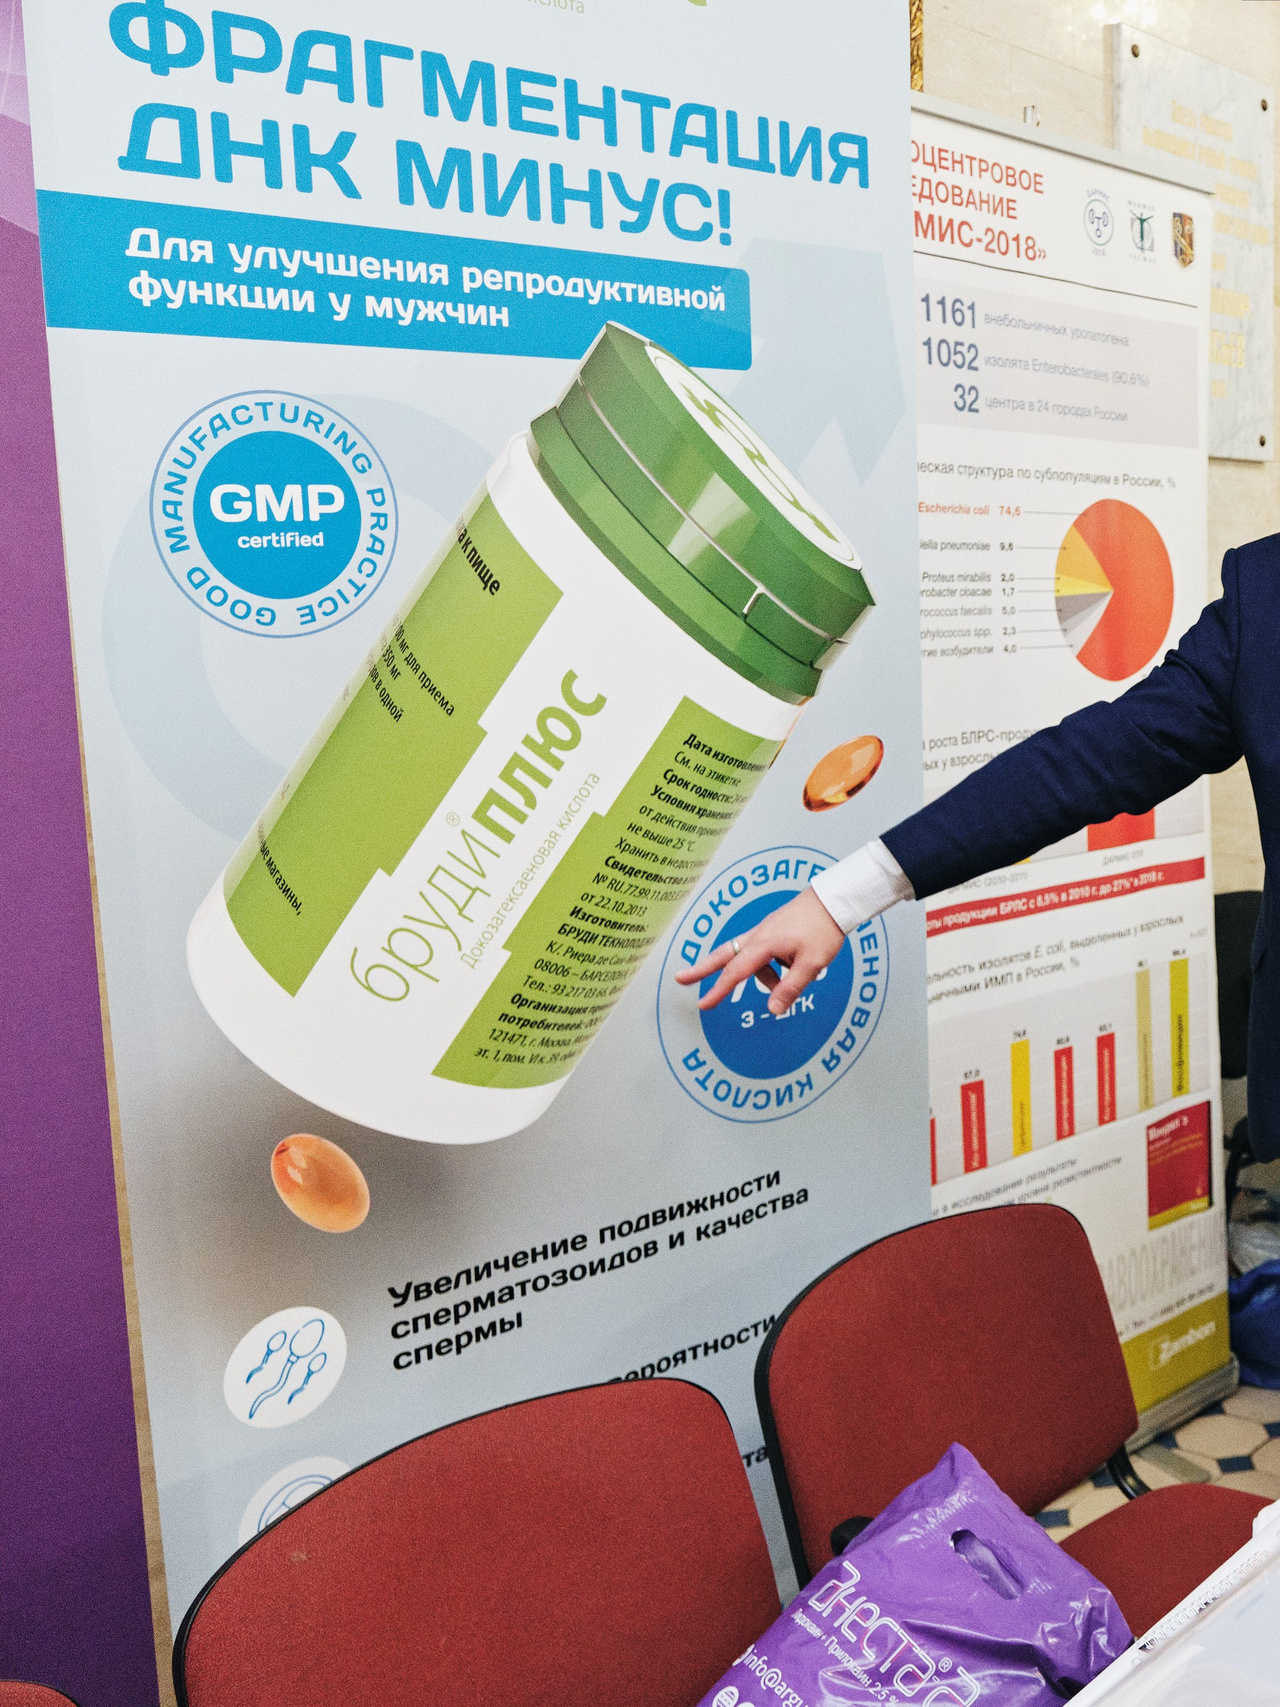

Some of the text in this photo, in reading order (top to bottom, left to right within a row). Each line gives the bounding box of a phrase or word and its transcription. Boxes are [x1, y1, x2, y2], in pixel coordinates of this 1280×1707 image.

[108, 0, 871, 189] ФРАГМЕНТАЦИЯ
[118, 102, 733, 246] ДНК МИНУС!
[125, 228, 727, 314] Для улучшения репродуктивной
[128, 271, 510, 329] функции у мужчин
[921, 293, 977, 329] 1161
[922, 336, 980, 372] 1052
[953, 383, 980, 414] 32
[956, 464, 1015, 481] структура
[1016, 466, 1032, 480] по
[162, 401, 389, 627] GOOD MANUFACTURING PRACTICE
[209, 483, 346, 524] GMP
[237, 531, 325, 549] certified
[417, 669, 456, 718] приема
[682, 733, 713, 757] Дата
[662, 767, 692, 791] Срок
[674, 750, 691, 770] См.
[693, 762, 707, 776] на
[639, 803, 653, 818] от
[650, 784, 697, 814] Условия
[614, 836, 660, 864] Хранить
[626, 821, 643, 835] не
[642, 828, 674, 849] выше
[459, 830, 561, 971] Докозагексаеновая
[558, 771, 601, 834] кислота
[580, 892, 595, 904] от
[557, 922, 600, 945] БРУДИ
[569, 904, 650, 933] Изготовитель:
[510, 992, 588, 1016] Организация
[682, 1047, 815, 1112] КИСЛОТА
[387, 1166, 782, 1310] Увеличение подвижности
[389, 1186, 810, 1342] сперматозоидов и качества
[391, 1311, 525, 1372] спермы
